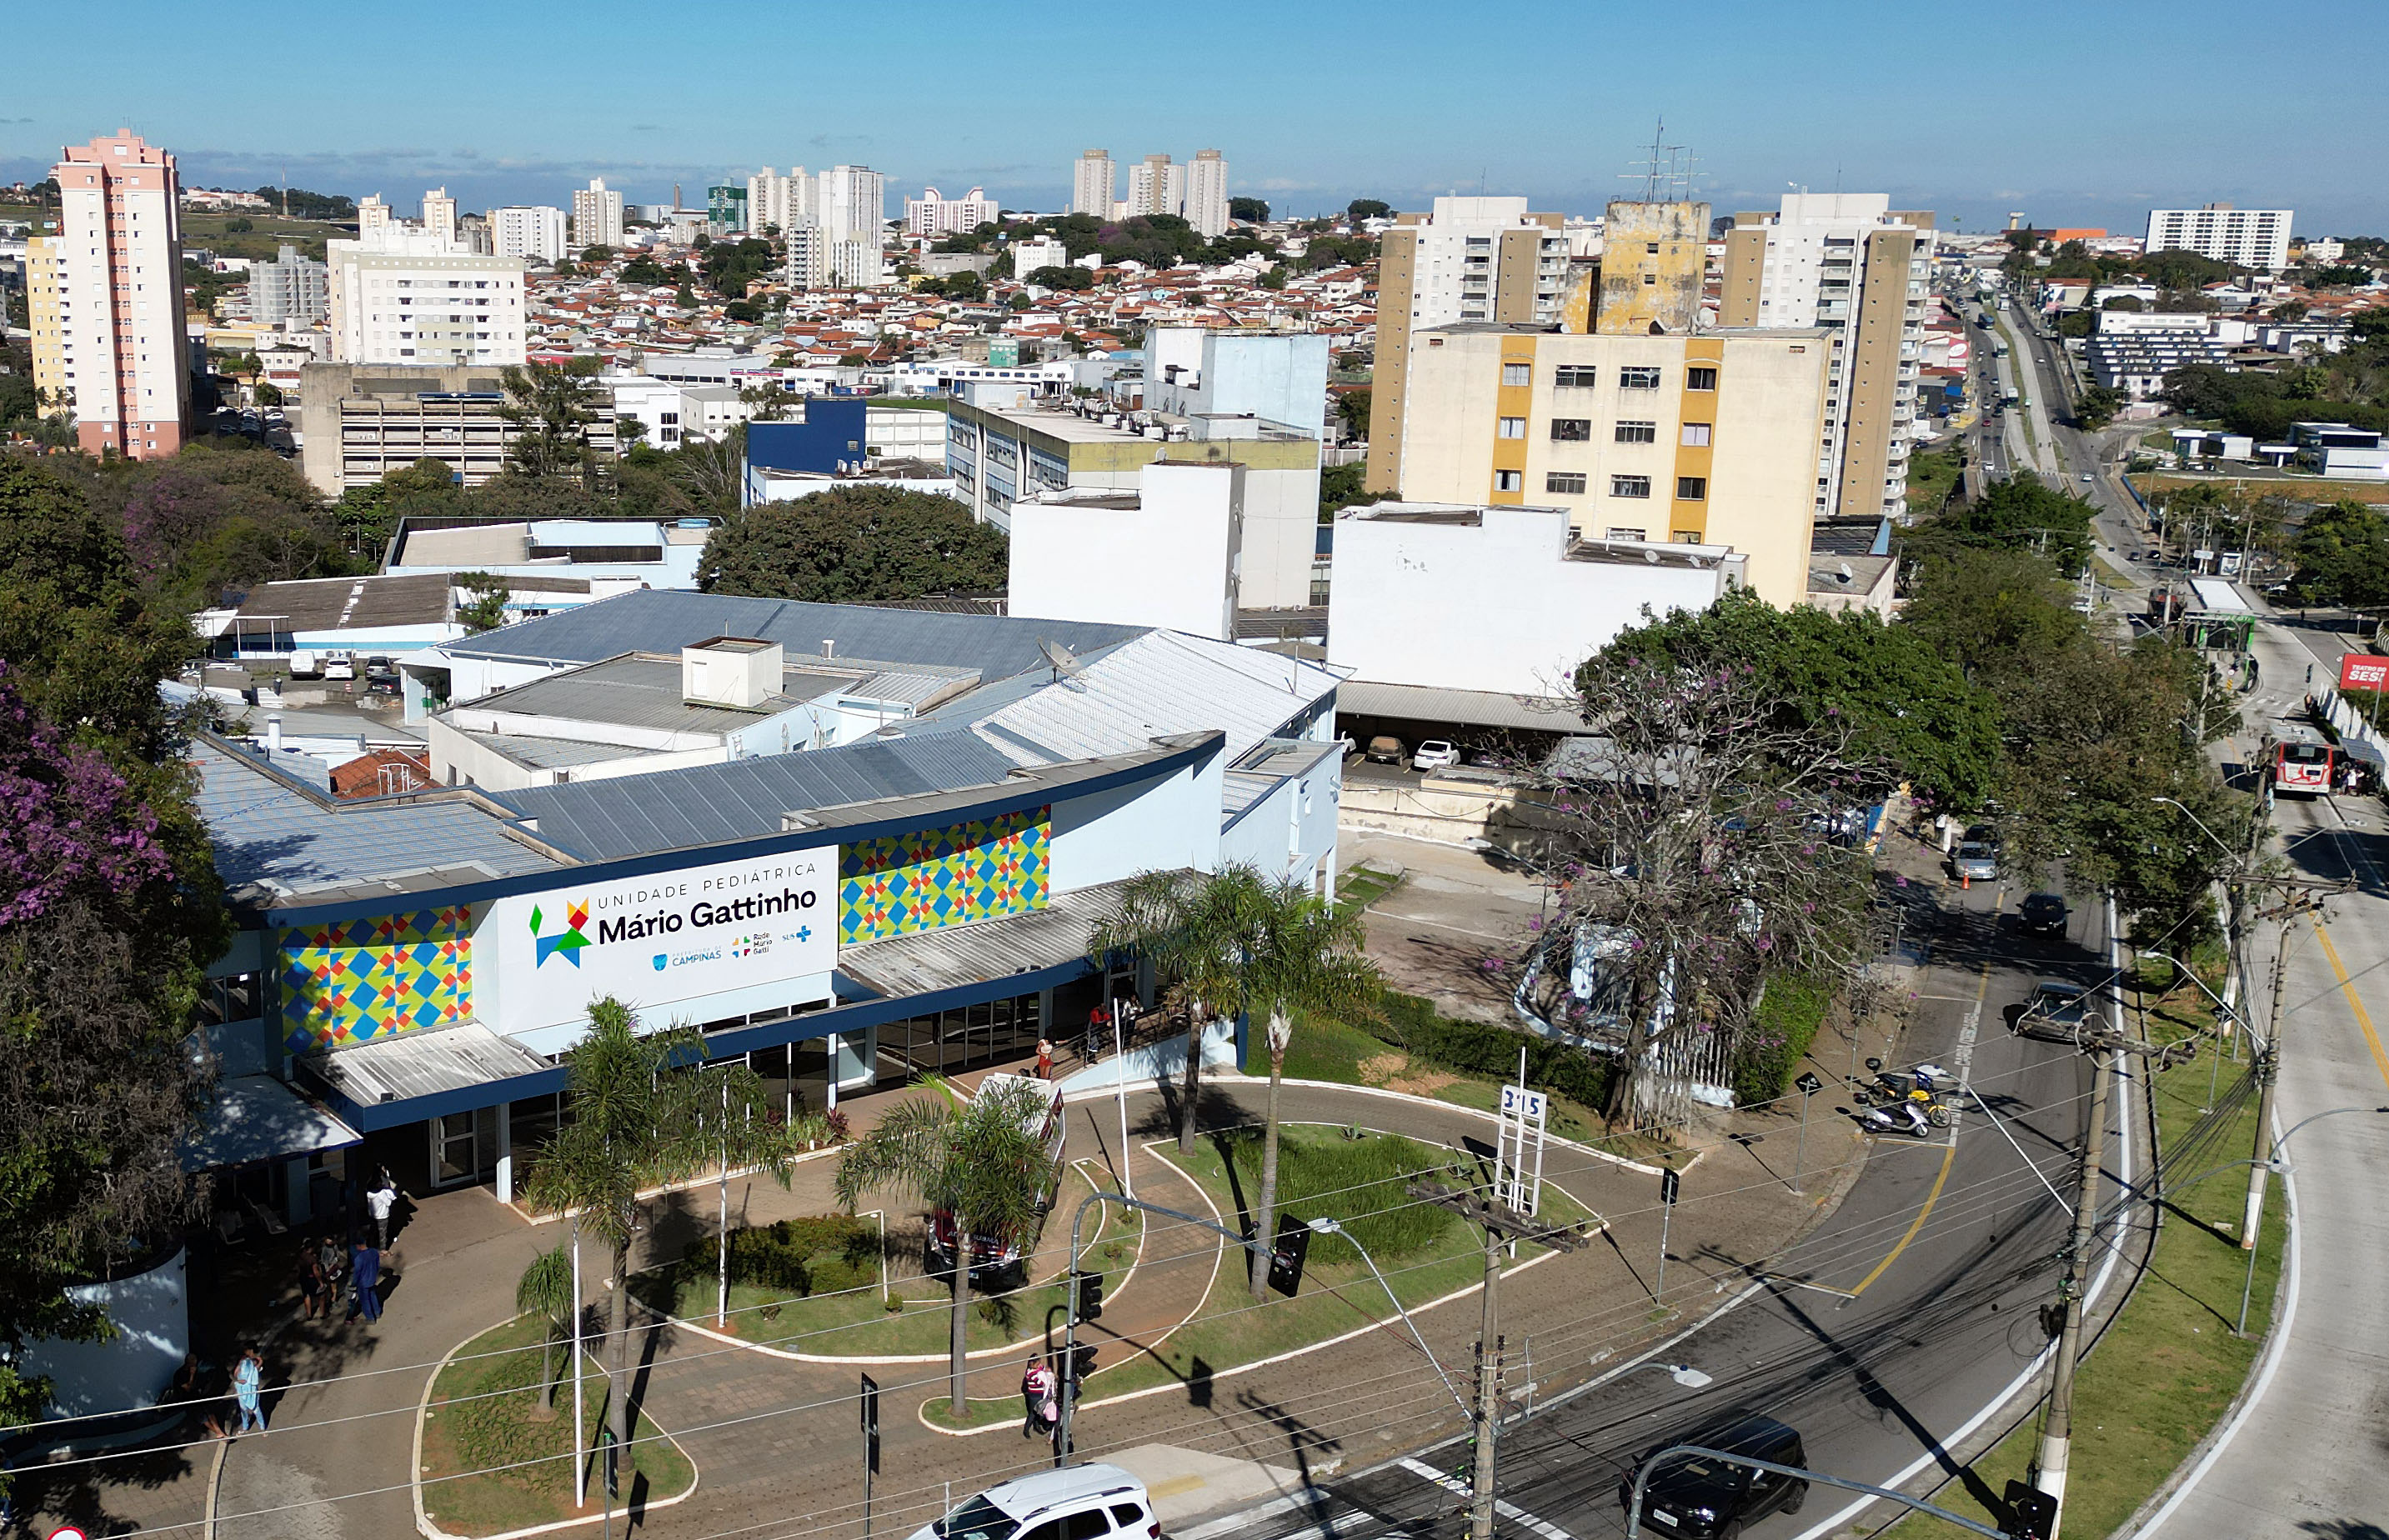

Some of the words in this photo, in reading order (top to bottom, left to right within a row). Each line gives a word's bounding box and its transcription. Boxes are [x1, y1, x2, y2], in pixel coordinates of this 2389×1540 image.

[2348, 670, 2385, 682] SESI
[599, 883, 688, 909] UNIDADE
[704, 862, 816, 892] PEDIÁTRICA
[599, 909, 683, 945] Mário
[690, 888, 817, 928] Gattinho
[781, 932, 795, 941] SUS
[672, 950, 722, 967] CAMPINAS
[1504, 1090, 1540, 1115] 315
